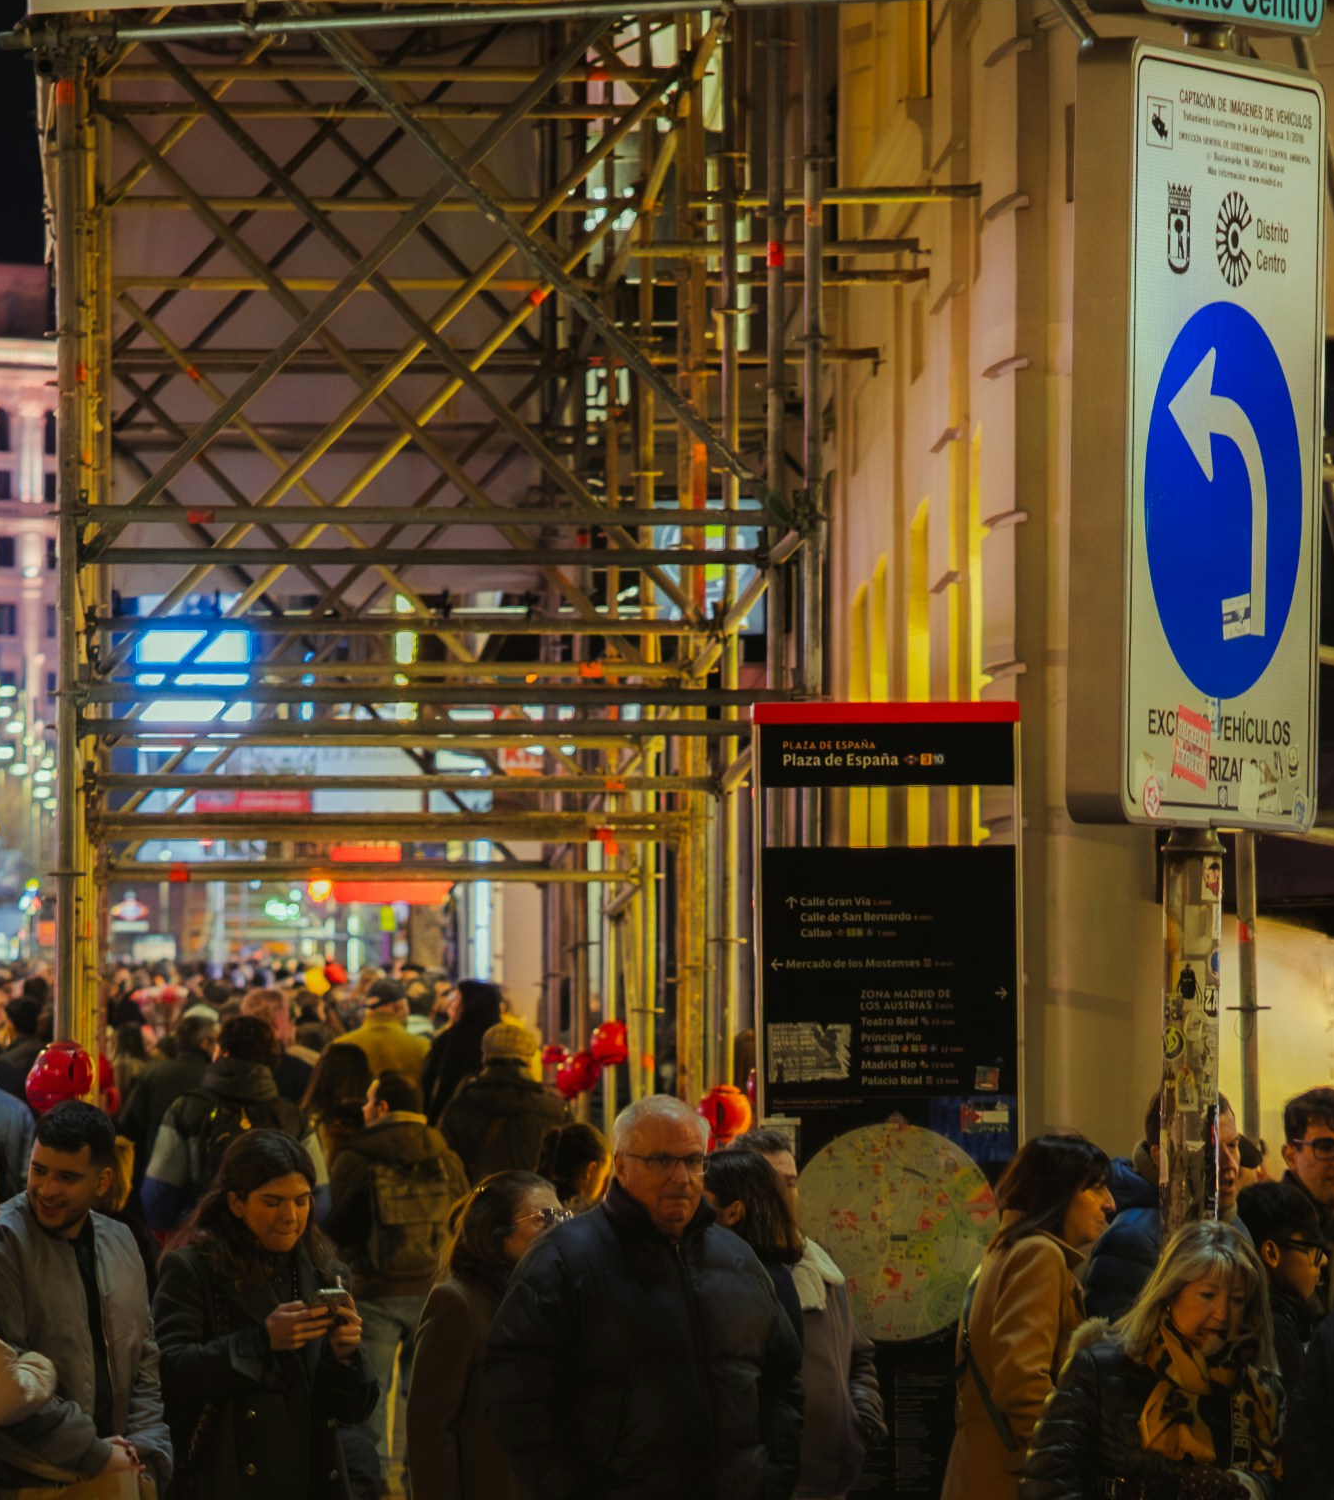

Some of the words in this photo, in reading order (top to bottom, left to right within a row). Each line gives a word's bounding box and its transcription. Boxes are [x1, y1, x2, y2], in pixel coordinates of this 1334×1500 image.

[1179, 89, 1216, 109] CAPTACIÓN
[1218, 97, 1227, 112] DE
[1230, 98, 1263, 120] IMÁGENES
[1265, 107, 1274, 121] DE
[1276, 108, 1313, 130] VEHÍCULOS
[1249, 124, 1259, 136] Ley
[1255, 217, 1290, 244] Distrito
[1255, 248, 1287, 274] Centro
[782, 740, 816, 749] PLAZA
[819, 740, 832, 749] DE
[835, 738, 876, 749] ESPAÑA
[782, 753, 821, 766] Plaza
[824, 753, 843, 766] de
[846, 753, 899, 769] España
[800, 897, 826, 907] Calle
[827, 897, 852, 907] Gran
[854, 895, 871, 907] Vía
[800, 912, 826, 922] Calle
[827, 912, 841, 922] de
[842, 912, 861, 922] San
[863, 911, 911, 922] Bernardo
[800, 928, 832, 938] Callao
[786, 959, 832, 969] Mercado
[833, 959, 846, 968] de
[848, 959, 863, 968] los
[865, 959, 921, 968] Mostenses
[860, 989, 891, 999] ZONA
[893, 989, 935, 999] MADRID
[937, 989, 952, 998] DE
[860, 1001, 881, 1011] LOS
[883, 1001, 932, 1010] AUSTRIAS
[860, 1016, 894, 1026] Teatro
[896, 1016, 918, 1026] Real
[861, 1031, 904, 1045] Príncipe
[861, 1059, 898, 1070] Madrid
[861, 1075, 898, 1085] Palacio
[900, 1075, 923, 1085] Real
